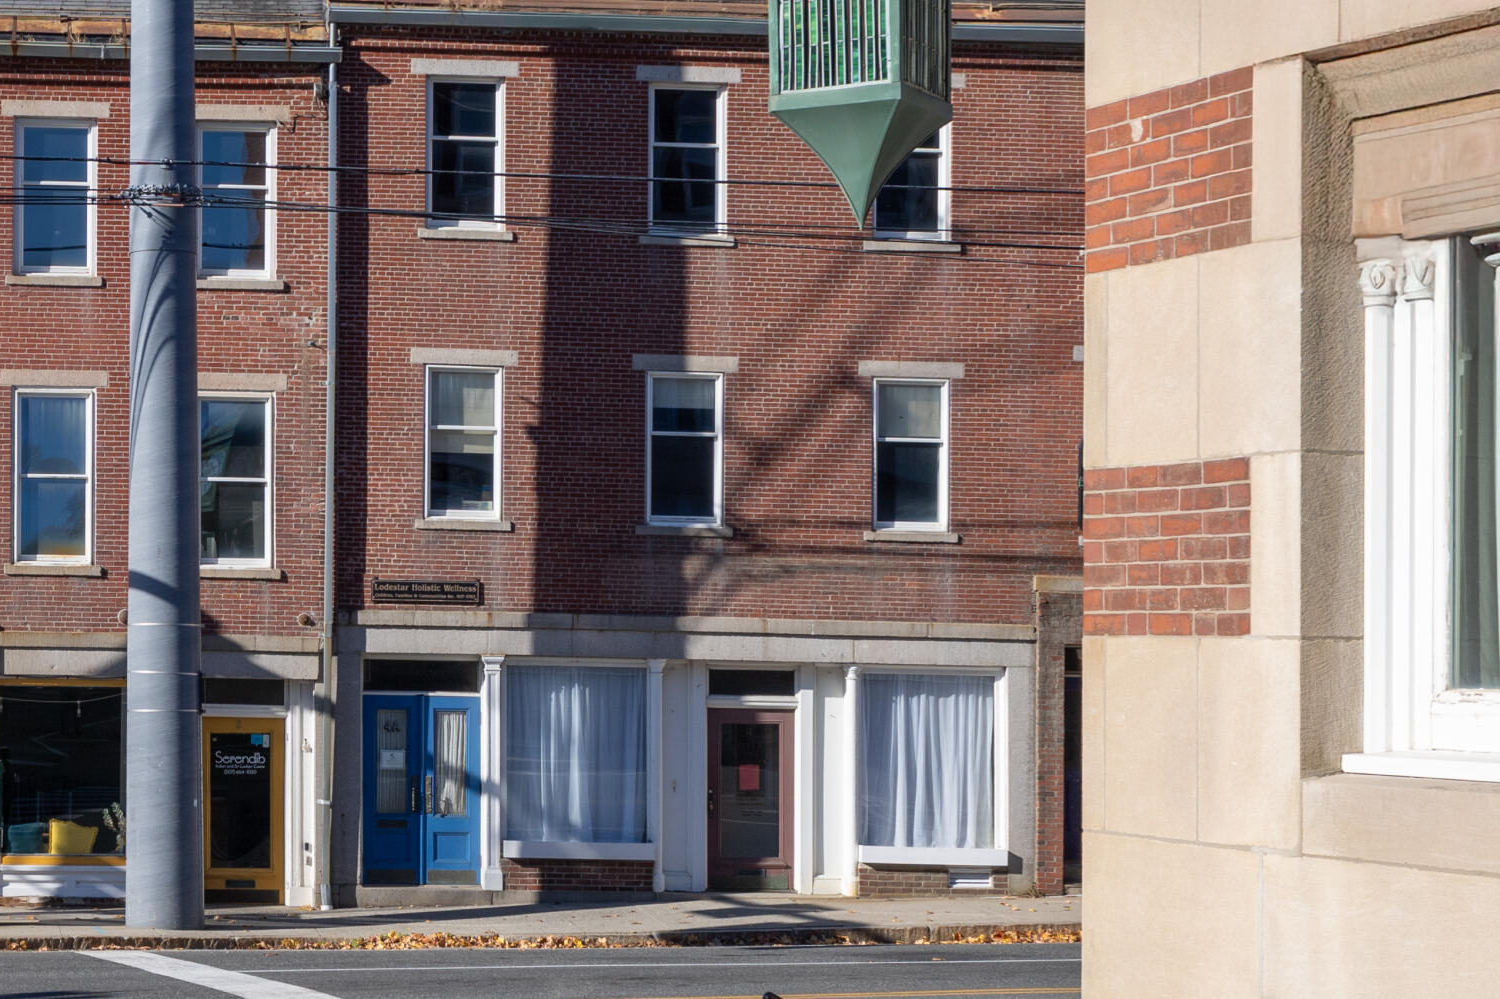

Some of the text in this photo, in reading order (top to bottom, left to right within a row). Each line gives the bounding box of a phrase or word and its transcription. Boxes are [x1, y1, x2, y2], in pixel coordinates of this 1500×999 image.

[374, 583, 477, 592] Lodestar Holistic Wellness
[215, 751, 266, 764] Serendib
